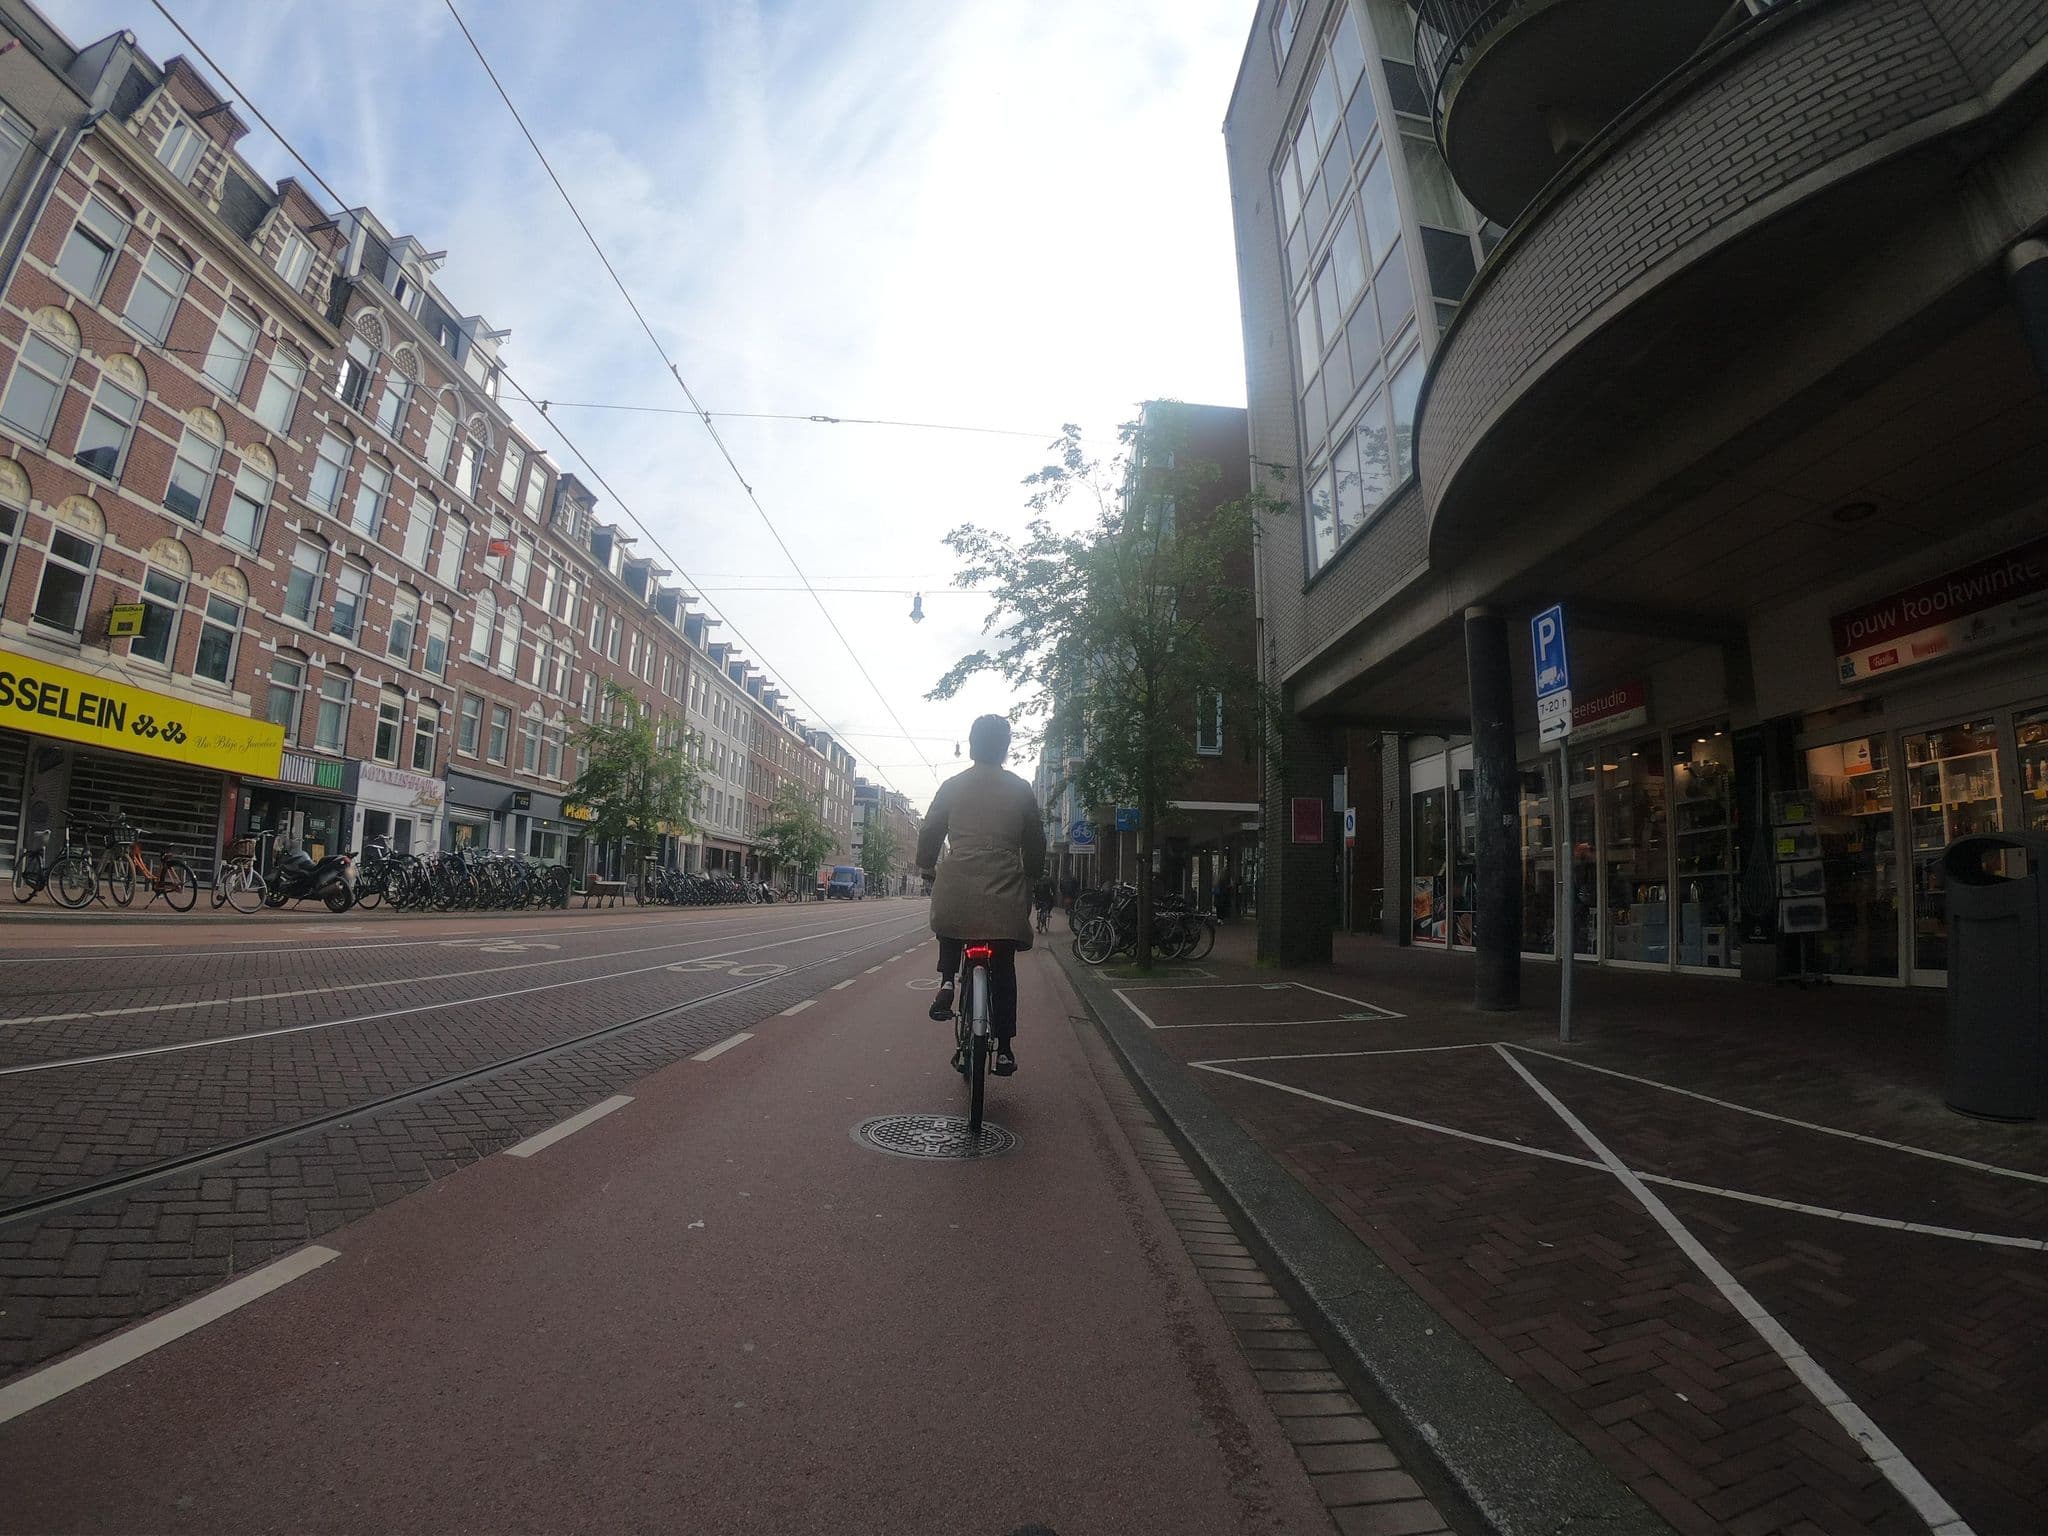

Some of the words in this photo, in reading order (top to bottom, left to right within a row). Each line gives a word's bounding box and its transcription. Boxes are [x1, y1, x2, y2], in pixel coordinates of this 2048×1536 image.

[1539, 617, 1556, 662] P
[1540, 701, 1560, 715] 7-20
[1562, 696, 1567, 708] h
[280, 752, 316, 785] INDIAN
[316, 760, 345, 790] MART
